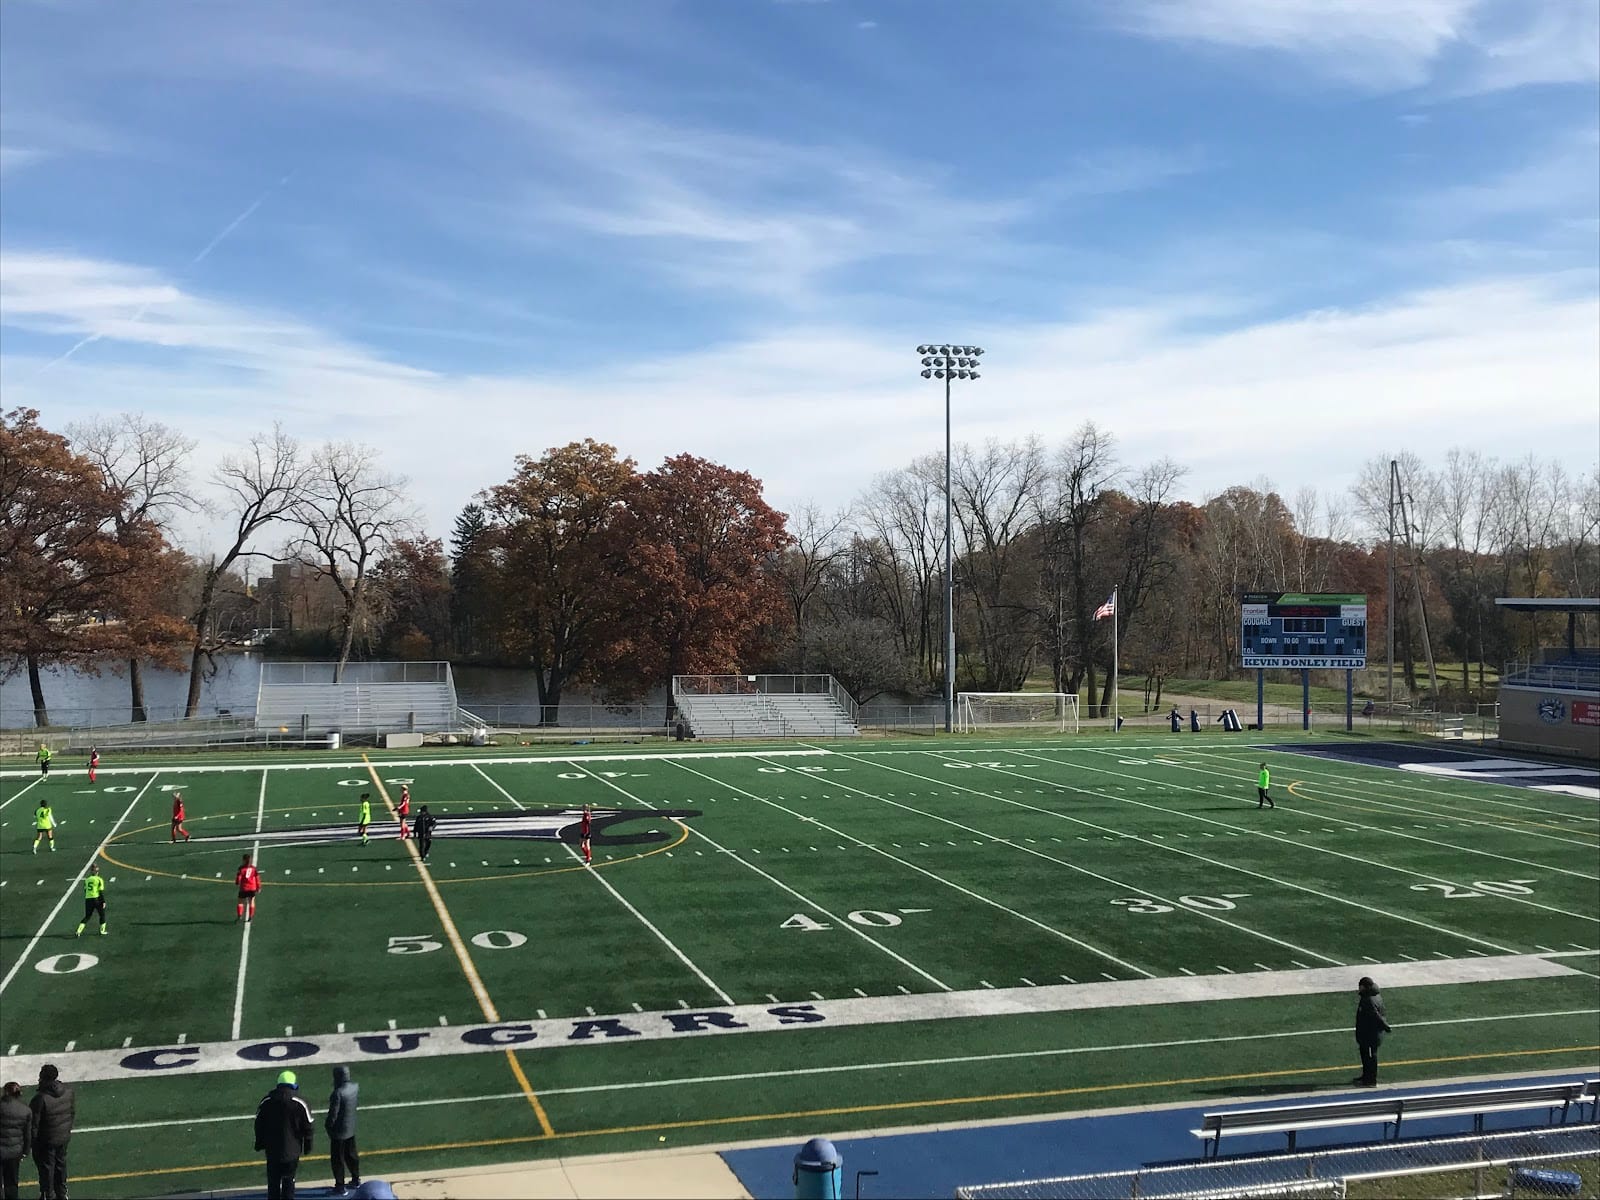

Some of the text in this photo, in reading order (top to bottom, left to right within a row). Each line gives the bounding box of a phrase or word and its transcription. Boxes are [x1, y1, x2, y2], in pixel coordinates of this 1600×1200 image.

[1341, 619, 1365, 627] GUEST
[1244, 658, 1364, 667] KEVIN DONLEY FIELD
[386, 930, 529, 956] 50
[119, 1004, 827, 1071] COUGARS
